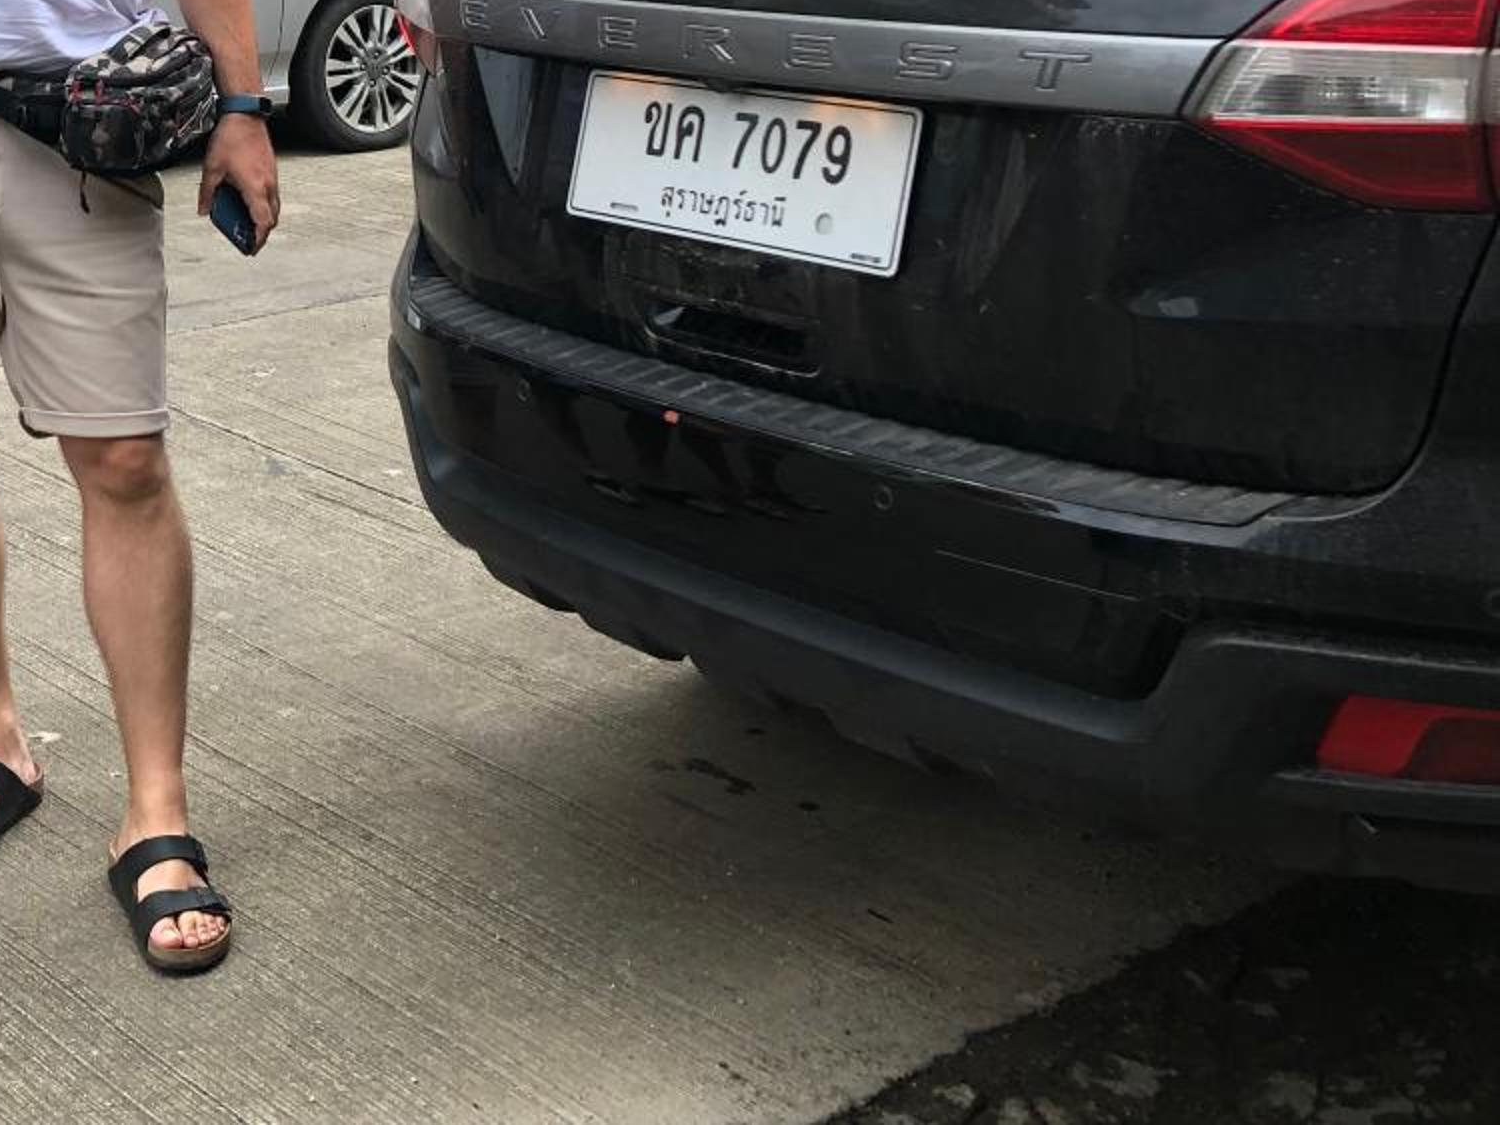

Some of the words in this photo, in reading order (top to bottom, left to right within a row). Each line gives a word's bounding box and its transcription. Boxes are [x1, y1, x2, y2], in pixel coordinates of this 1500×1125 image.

[644, 100, 706, 163] ขค
[731, 111, 853, 186] 7079
[659, 185, 787, 227] สุราษฎร์ธานี
